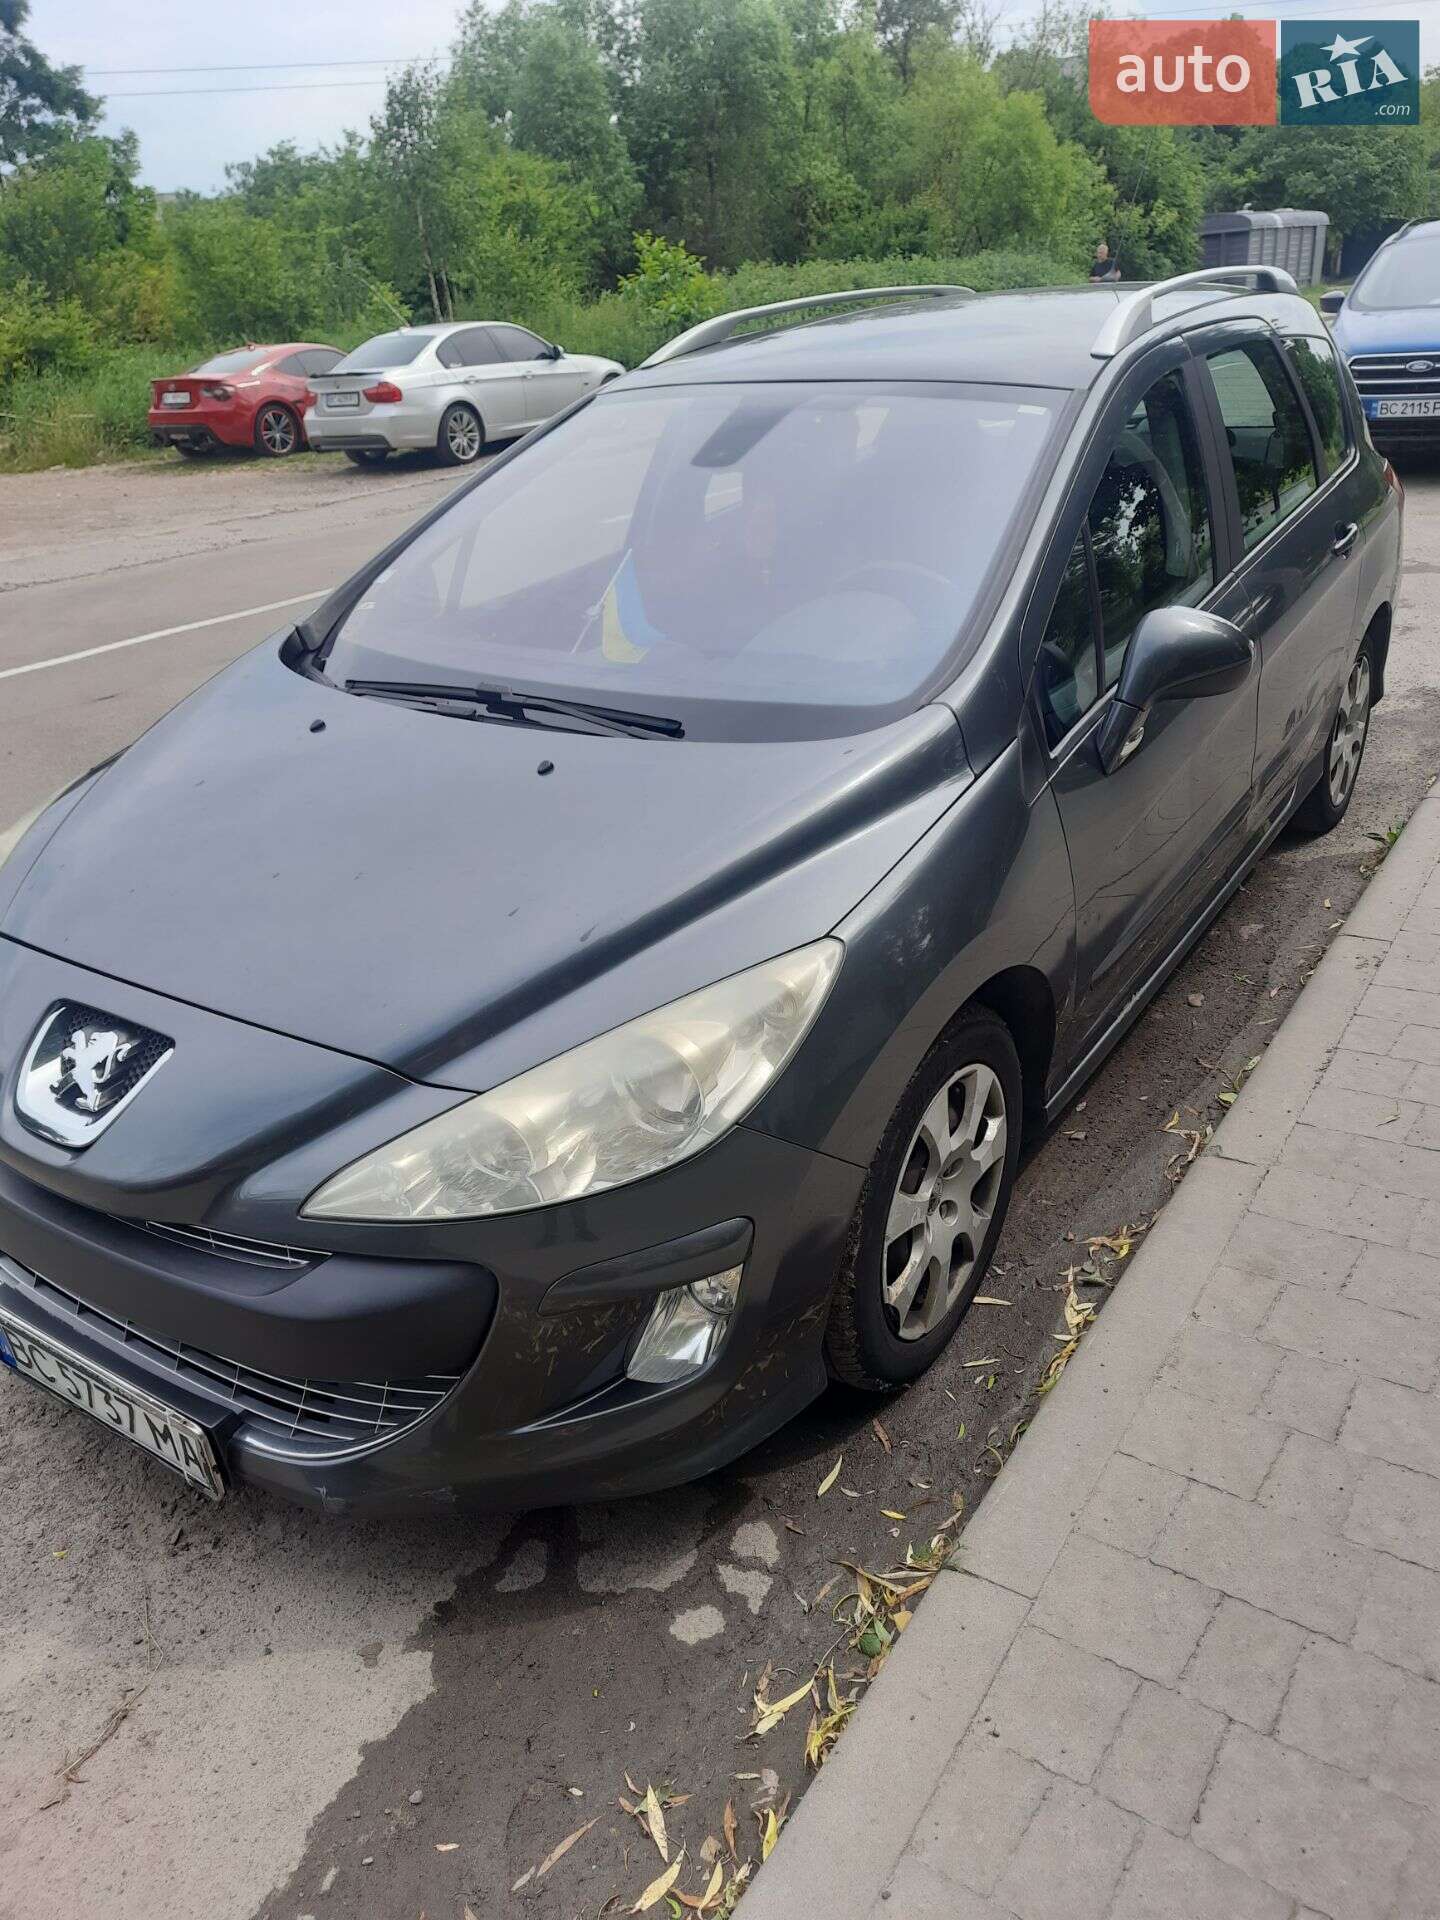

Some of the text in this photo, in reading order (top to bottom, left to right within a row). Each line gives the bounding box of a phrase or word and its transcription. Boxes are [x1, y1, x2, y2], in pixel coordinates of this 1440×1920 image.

[1380, 402, 1399, 415] BC
[1400, 402, 1430, 415] 2115
[2, 1326, 206, 1479] BC 5737 MA
